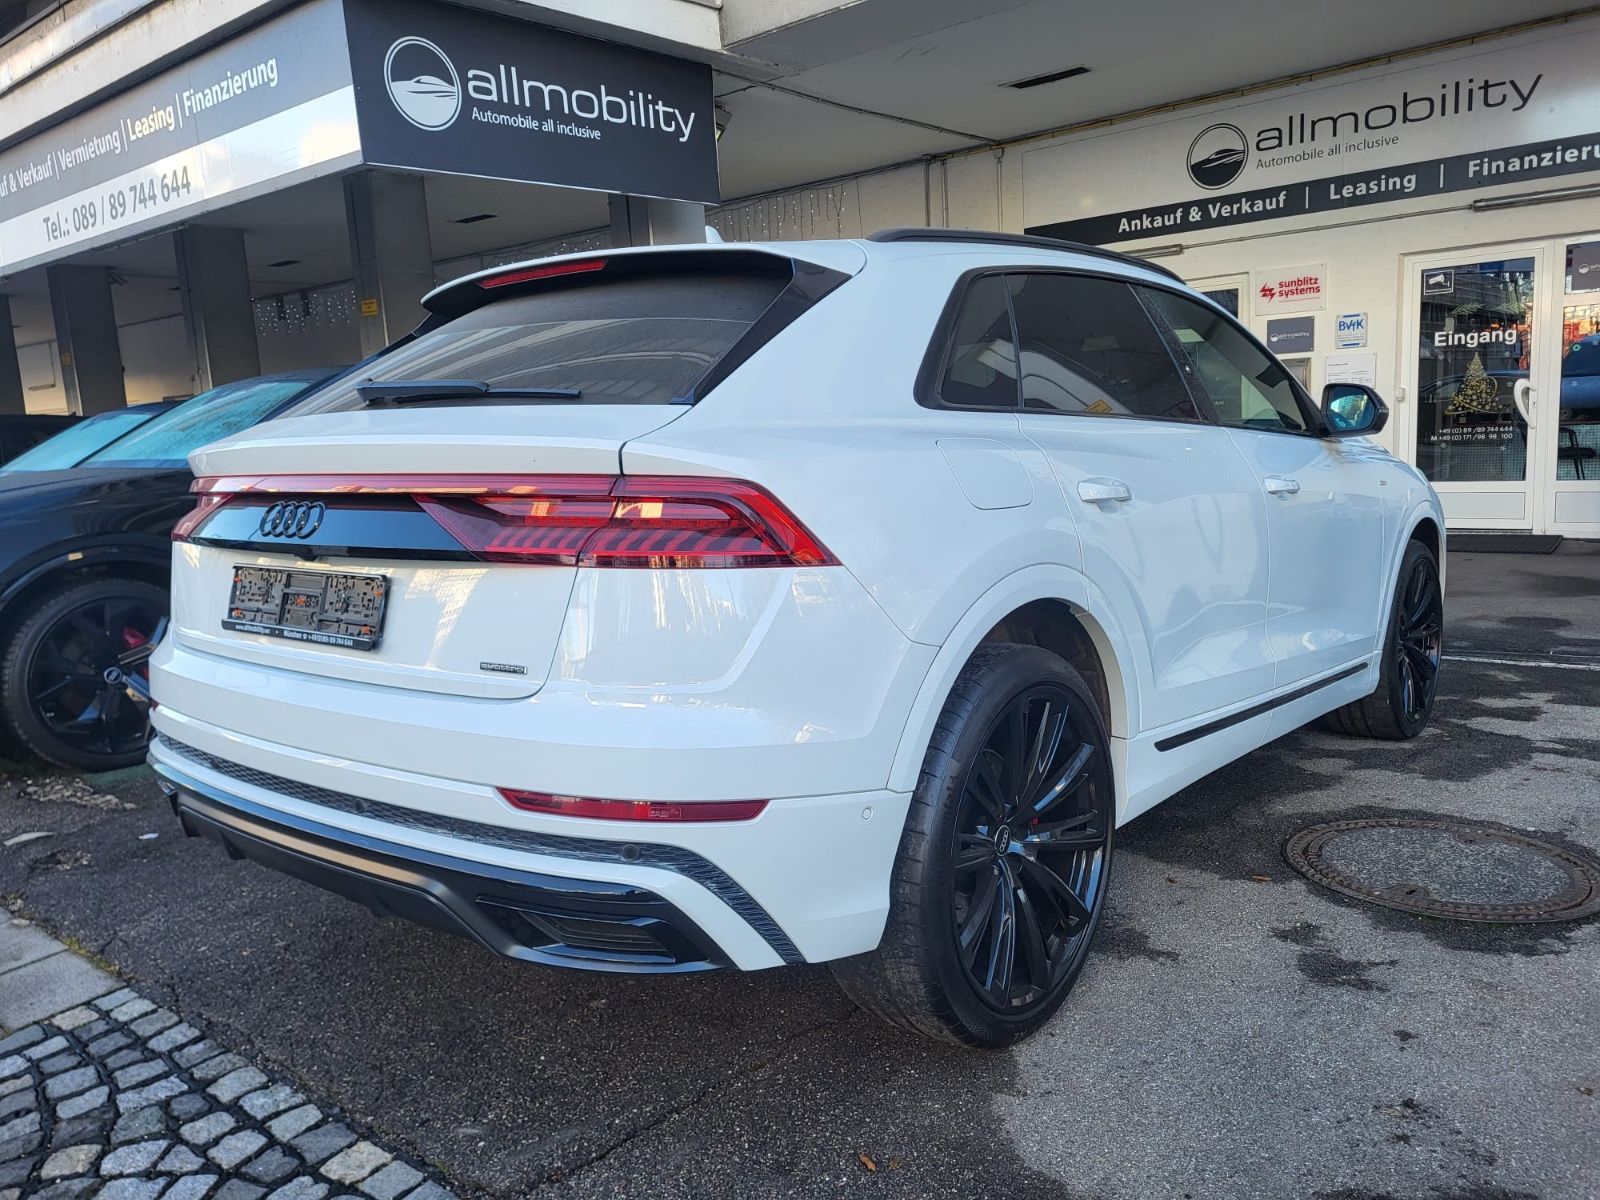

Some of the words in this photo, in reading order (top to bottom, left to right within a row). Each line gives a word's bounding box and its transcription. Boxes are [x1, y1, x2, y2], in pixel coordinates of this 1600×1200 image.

[16, 154, 53, 189] Verkauf
[58, 128, 121, 171] Vermietung
[126, 104, 175, 142] Leasing
[182, 57, 279, 117] Finanzierung
[467, 64, 695, 143] allmobility
[471, 107, 538, 131] Automobile
[541, 120, 554, 133] all
[557, 122, 601, 140] inclusive
[1256, 73, 1543, 152] allmobility
[1255, 150, 1324, 170] Automobile
[1327, 144, 1342, 156] all
[1345, 135, 1399, 153] inclusive
[43, 212, 70, 242] Tel.:
[72, 200, 97, 234] 089
[109, 190, 126, 220] 89
[129, 178, 157, 213] 744
[160, 165, 191, 202] 644
[1118, 209, 1183, 233] Ankauf
[1188, 206, 1202, 222] &
[1208, 191, 1287, 219] Verkauf
[1329, 171, 1417, 200] Leasing
[1278, 276, 1319, 289] sunblitz
[1278, 285, 1320, 298] systems
[1434, 329, 1517, 347] Eingang
